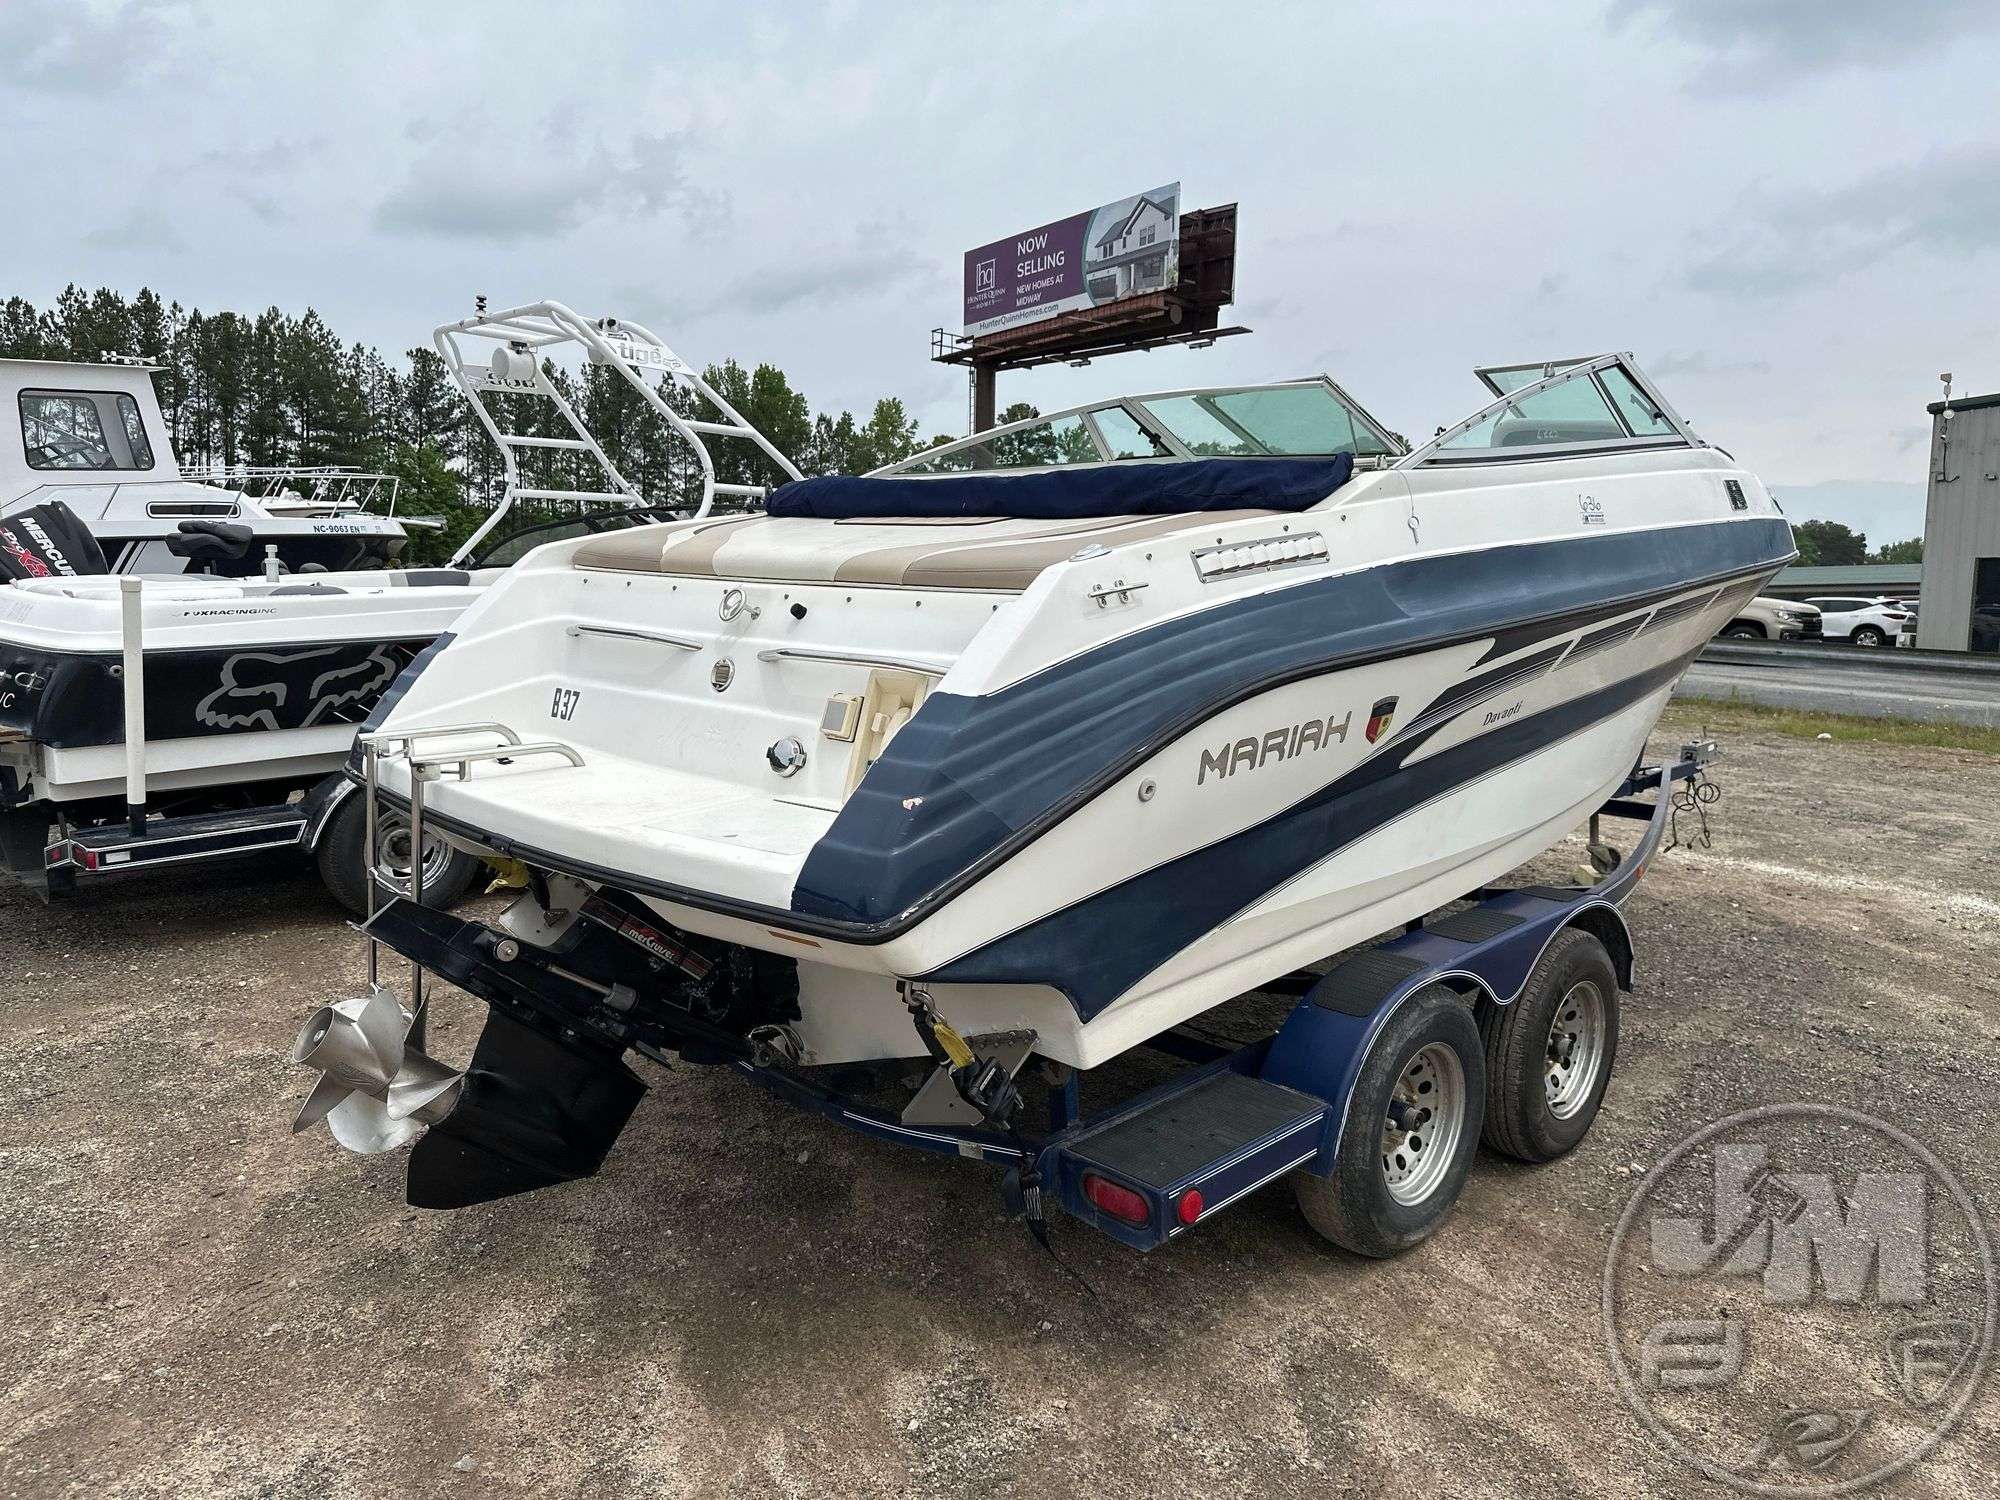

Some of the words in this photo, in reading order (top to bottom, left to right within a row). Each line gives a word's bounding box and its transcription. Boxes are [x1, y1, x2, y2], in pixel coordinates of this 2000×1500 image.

[1017, 233, 1048, 256] NOW
[1017, 250, 1065, 278] SELLING
[1016, 283, 1032, 295] NEW
[1032, 277, 1055, 291] HOMES
[1055, 274, 1065, 284] AT
[1016, 292, 1042, 307] MIDWAY
[979, 304, 1059, 330] HunterQuinnHomes.com
[551, 687, 581, 721] B37
[1482, 699, 1524, 726] Davanti
[1197, 711, 1352, 785] MARIAH
